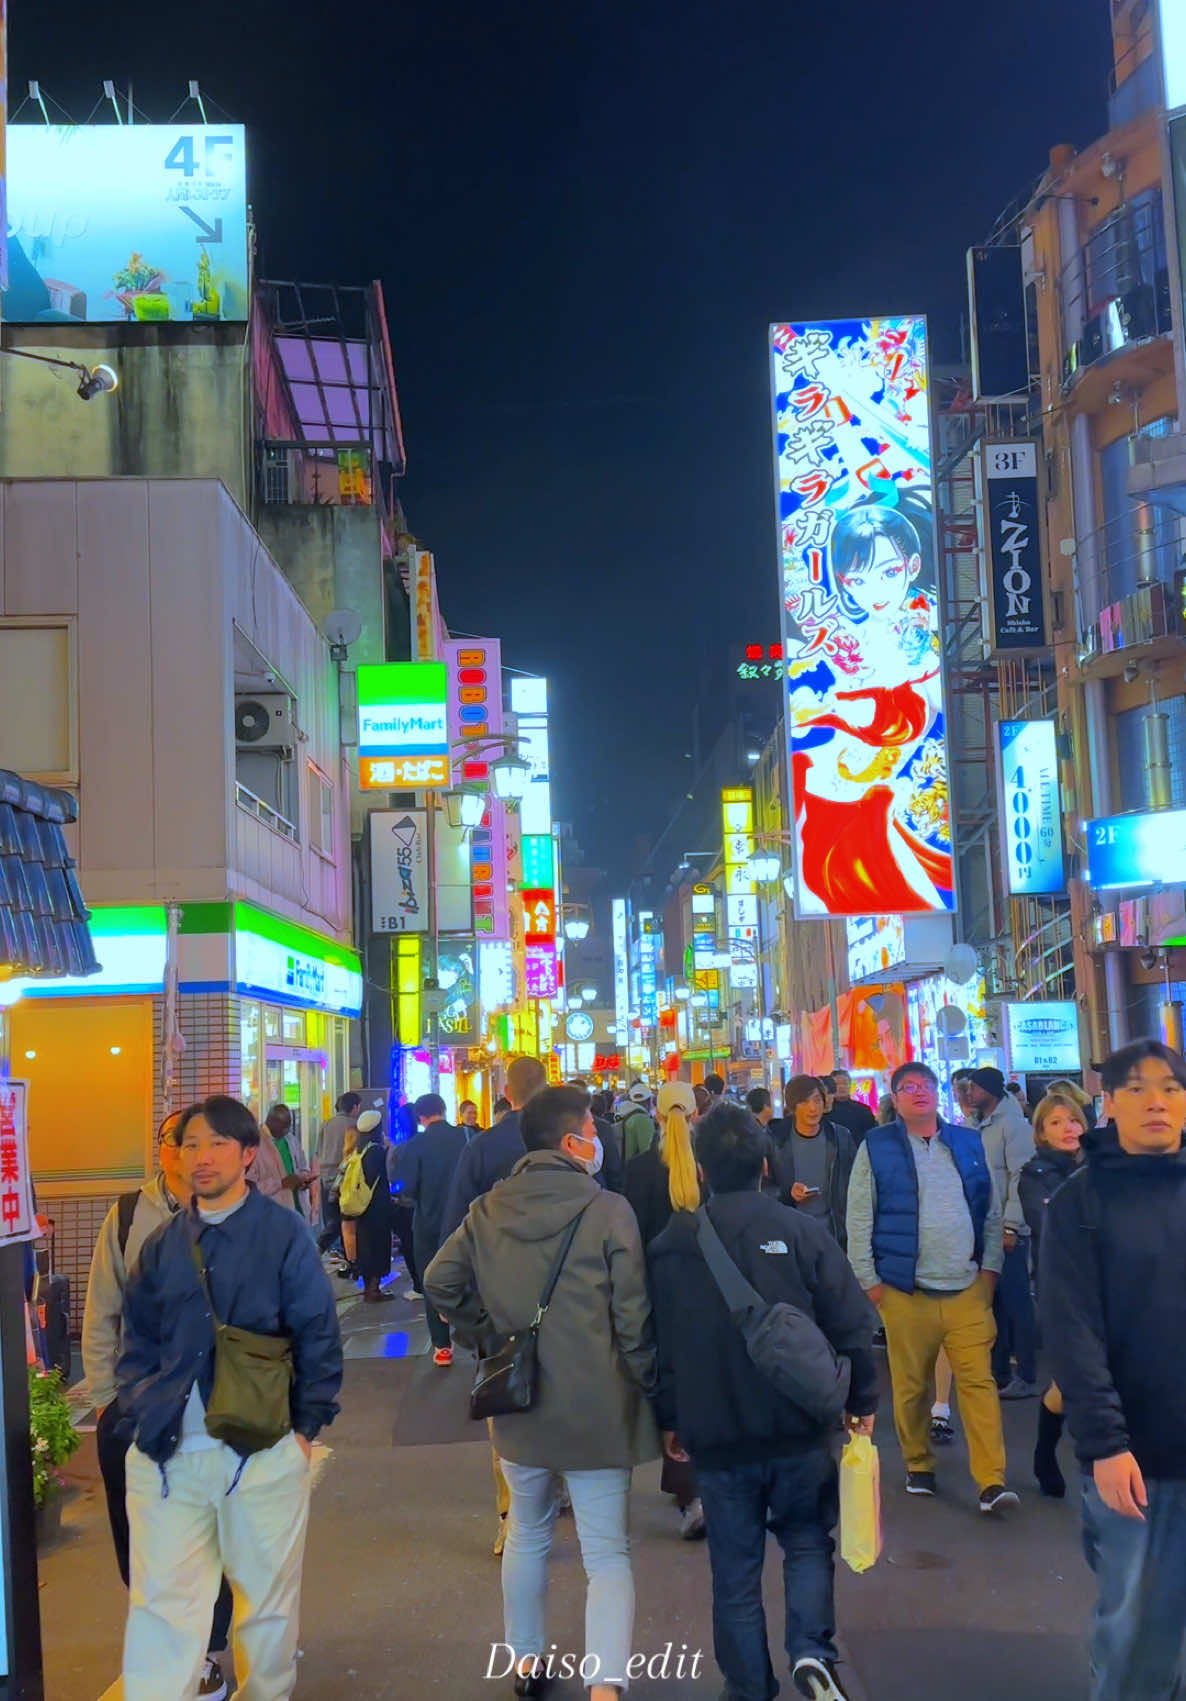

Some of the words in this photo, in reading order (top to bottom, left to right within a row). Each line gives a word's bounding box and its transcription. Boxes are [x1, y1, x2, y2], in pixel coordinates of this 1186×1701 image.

[164, 135, 234, 177] 4F
[995, 451, 1026, 471] 3F
[782, 331, 839, 660] ギラギラガールズ
[1001, 519, 1031, 617] ZION
[363, 717, 443, 733] FamilyMart
[1004, 726, 1020, 737] 2F
[1096, 826, 1120, 845] 2F
[388, 917, 406, 929] B1
